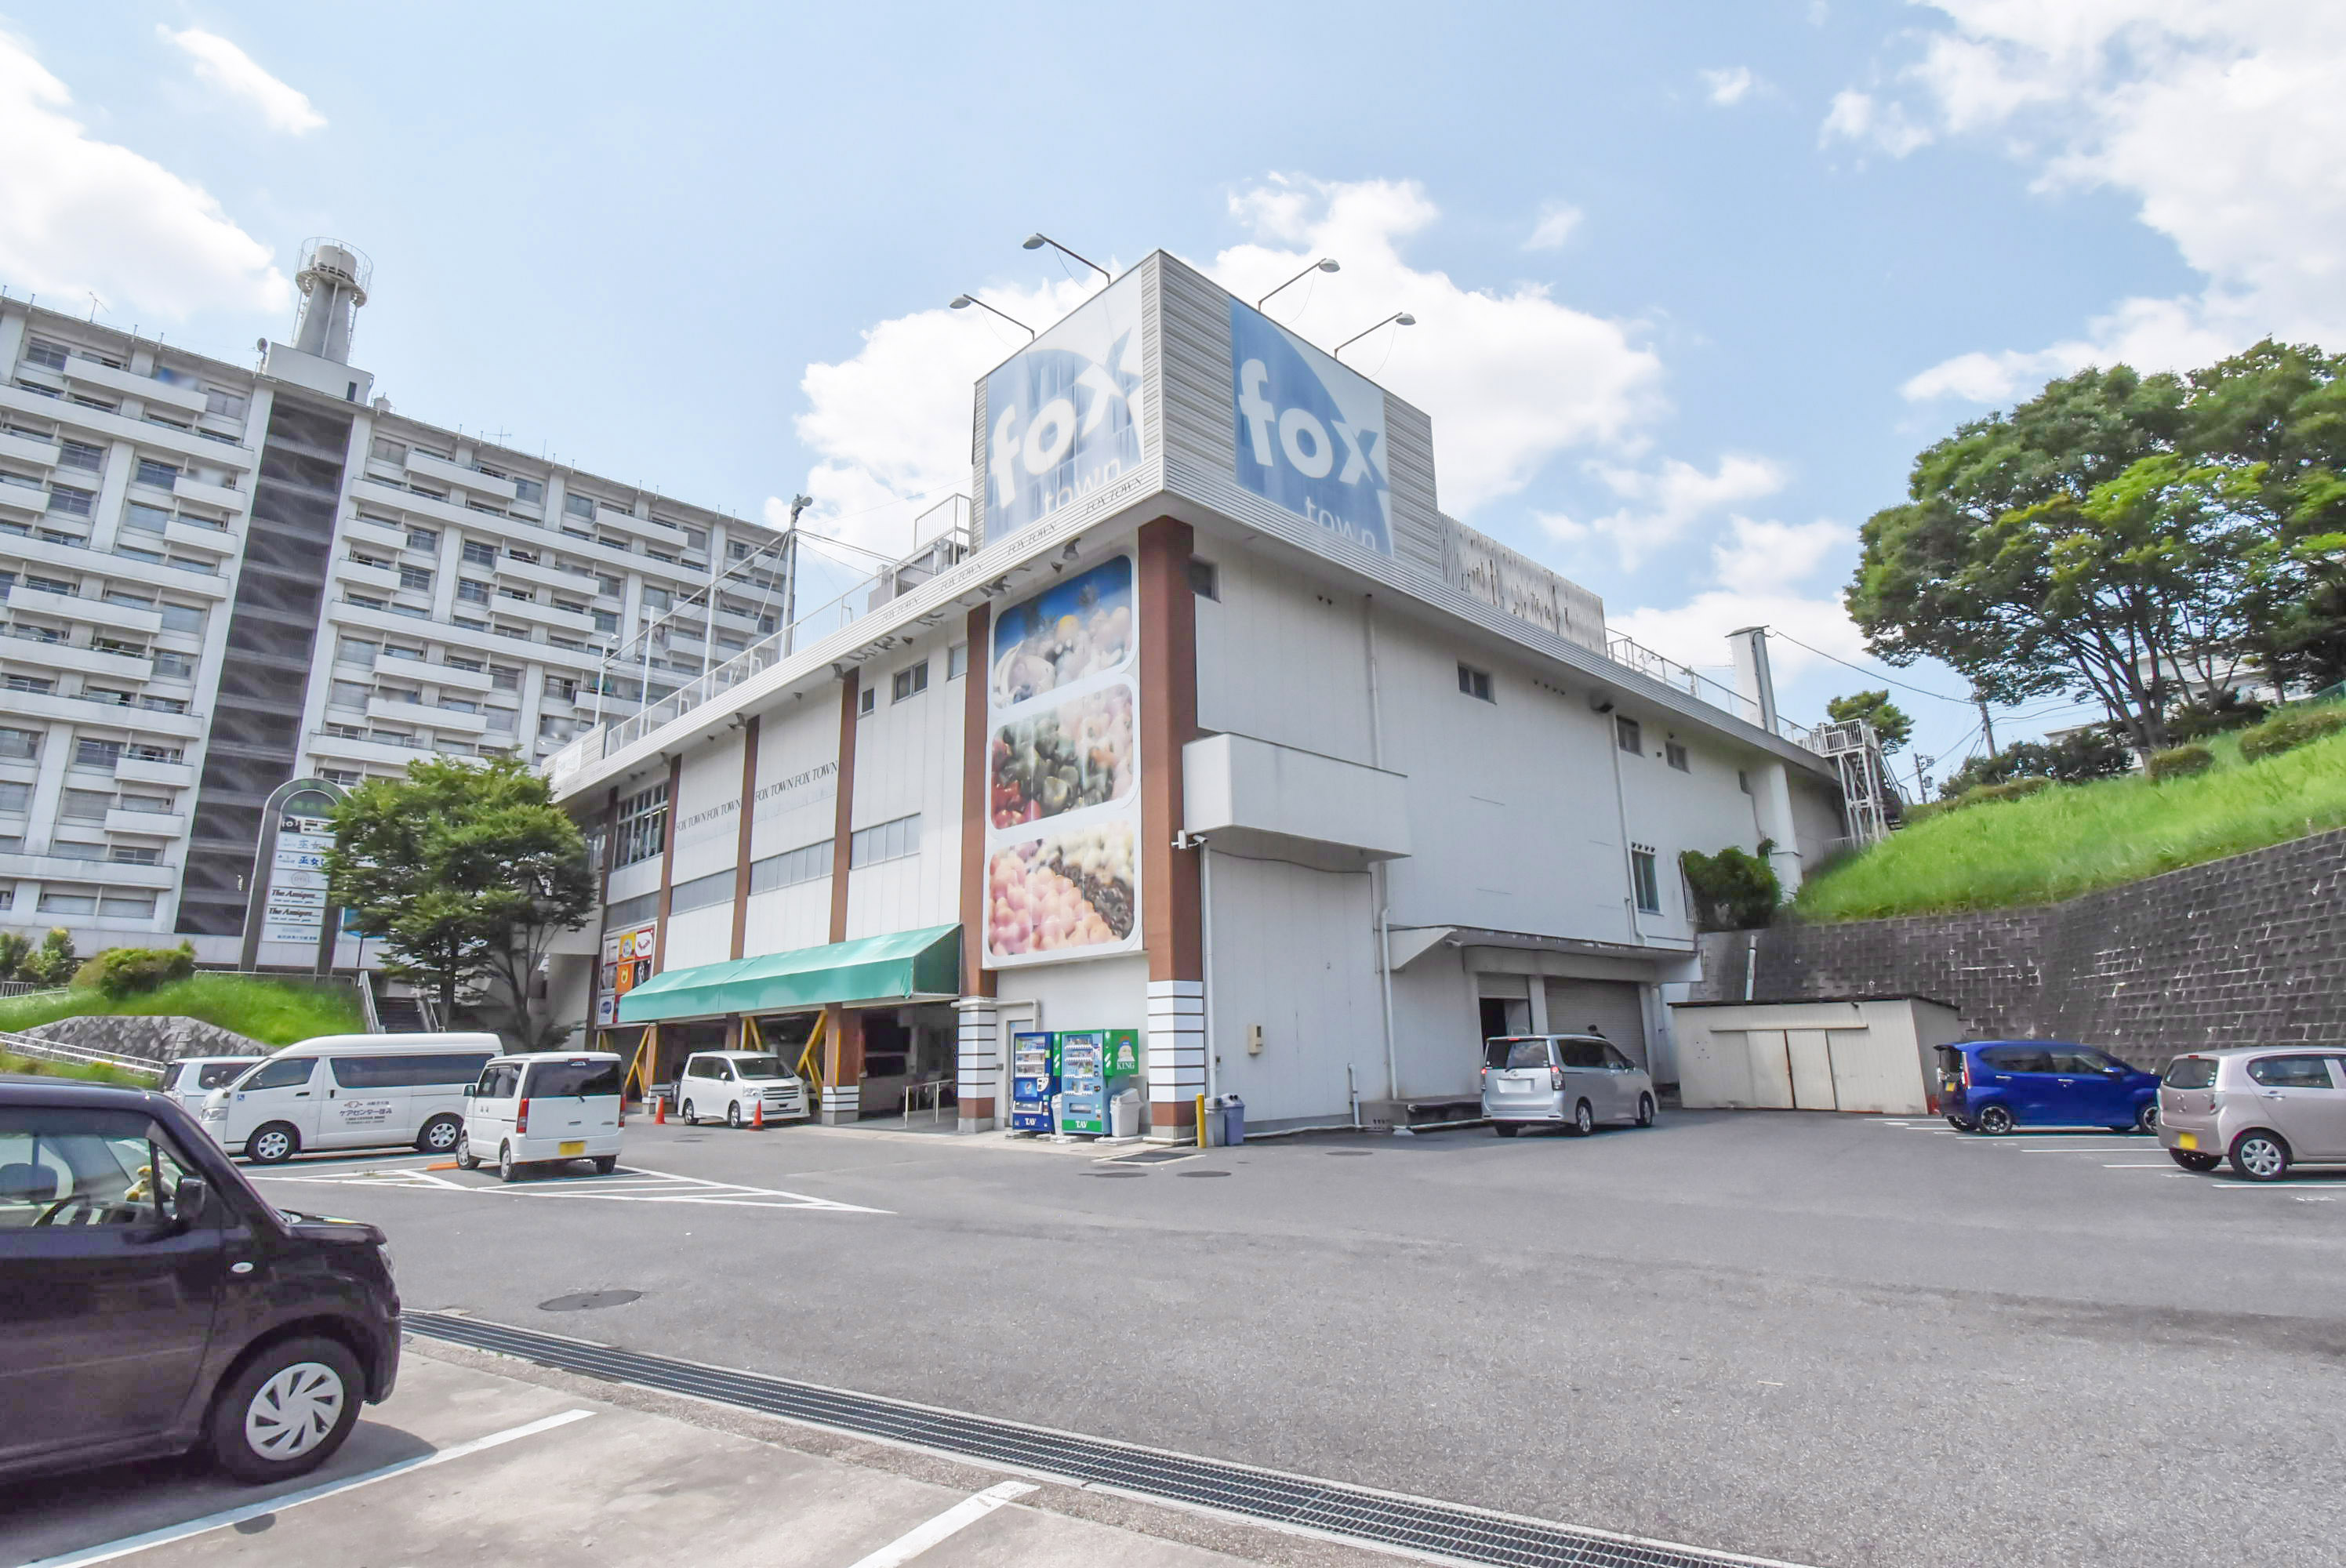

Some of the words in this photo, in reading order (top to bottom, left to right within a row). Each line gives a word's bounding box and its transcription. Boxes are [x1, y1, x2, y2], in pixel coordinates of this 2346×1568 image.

[990, 326, 1142, 509] fox
[1239, 358, 1378, 486] fox
[1044, 457, 1121, 516] town
[1084, 495, 1106, 514] FOX
[1109, 475, 1143, 502] TOWN
[1305, 495, 1376, 550] town
[754, 788, 769, 803] FOX
[771, 777, 794, 797] TOWN
[794, 771, 812, 788] FOX
[812, 760, 838, 781] TOWN
[676, 819, 688, 833] FOX
[688, 811, 706, 828] TOWN
[706, 806, 720, 821] FOX
[721, 798, 741, 816] TOWN
[1117, 1061, 1135, 1070] KING
